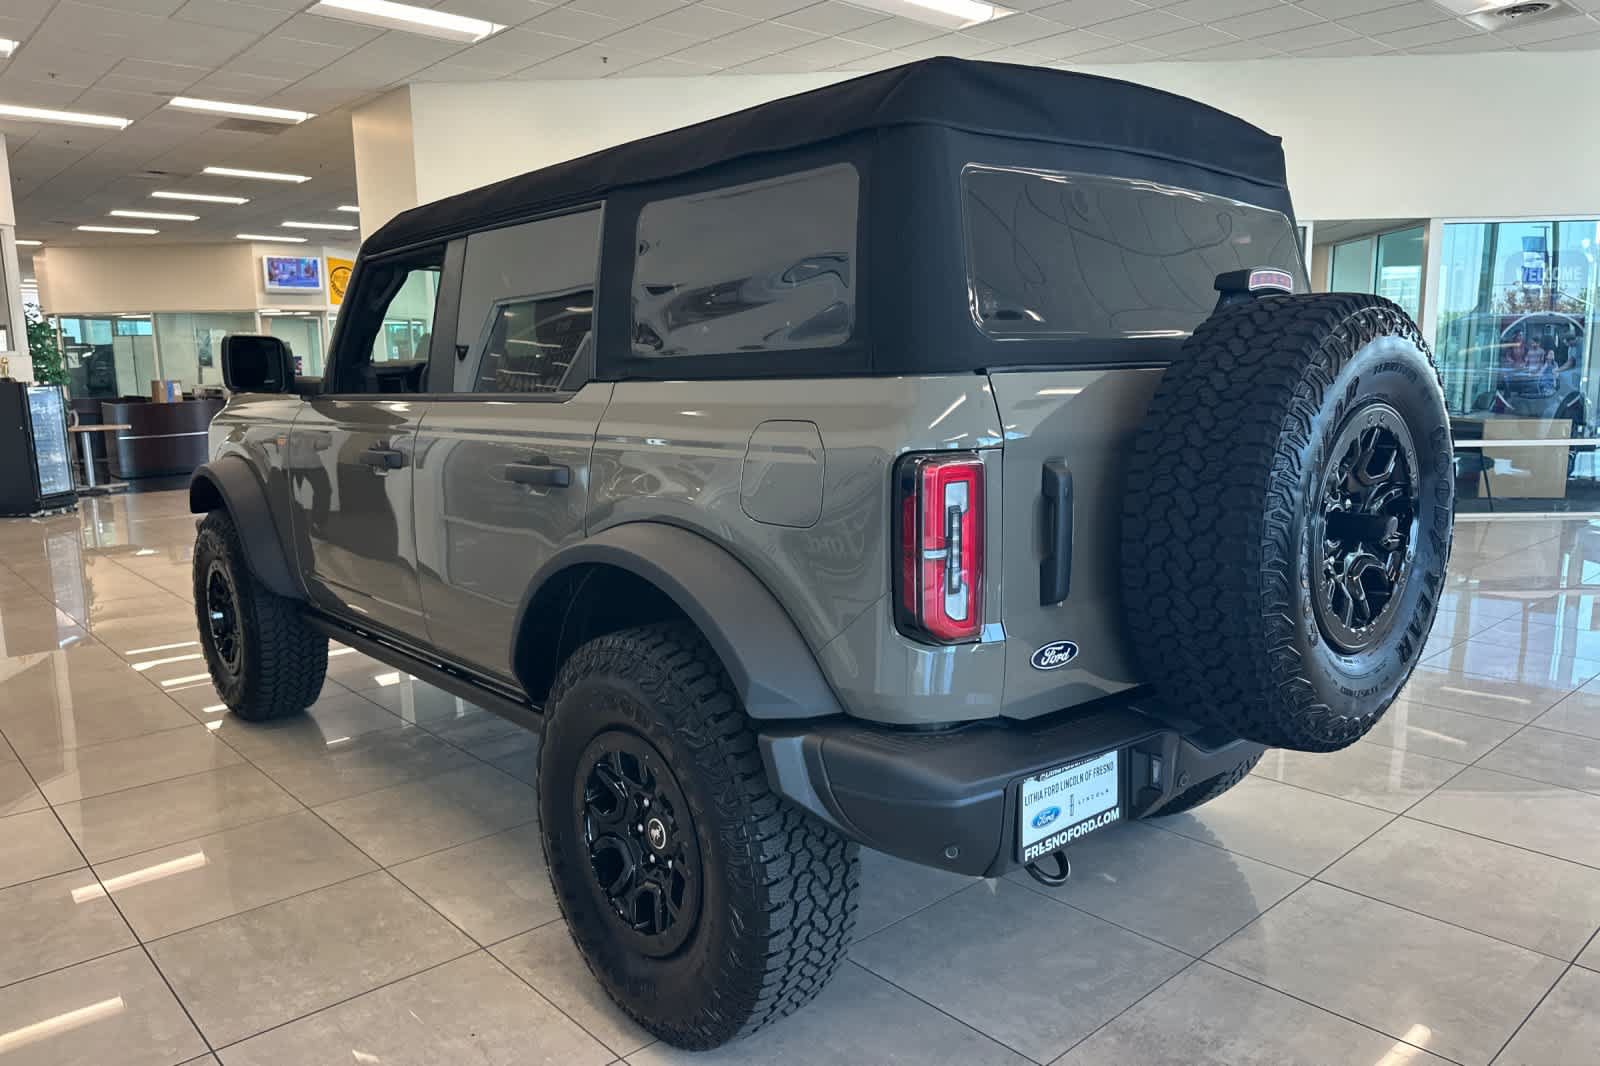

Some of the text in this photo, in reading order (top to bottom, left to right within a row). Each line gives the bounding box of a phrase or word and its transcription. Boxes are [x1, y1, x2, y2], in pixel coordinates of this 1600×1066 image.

[1041, 645, 1071, 665] Ford
[1025, 789, 1043, 807] LITHIA
[1044, 783, 1060, 797] FORD
[1060, 773, 1084, 791] LINCOLN
[1085, 769, 1092, 781] OF
[1093, 761, 1114, 780] FRESNO
[1024, 807, 1120, 862] FRESNOFORD.COM
